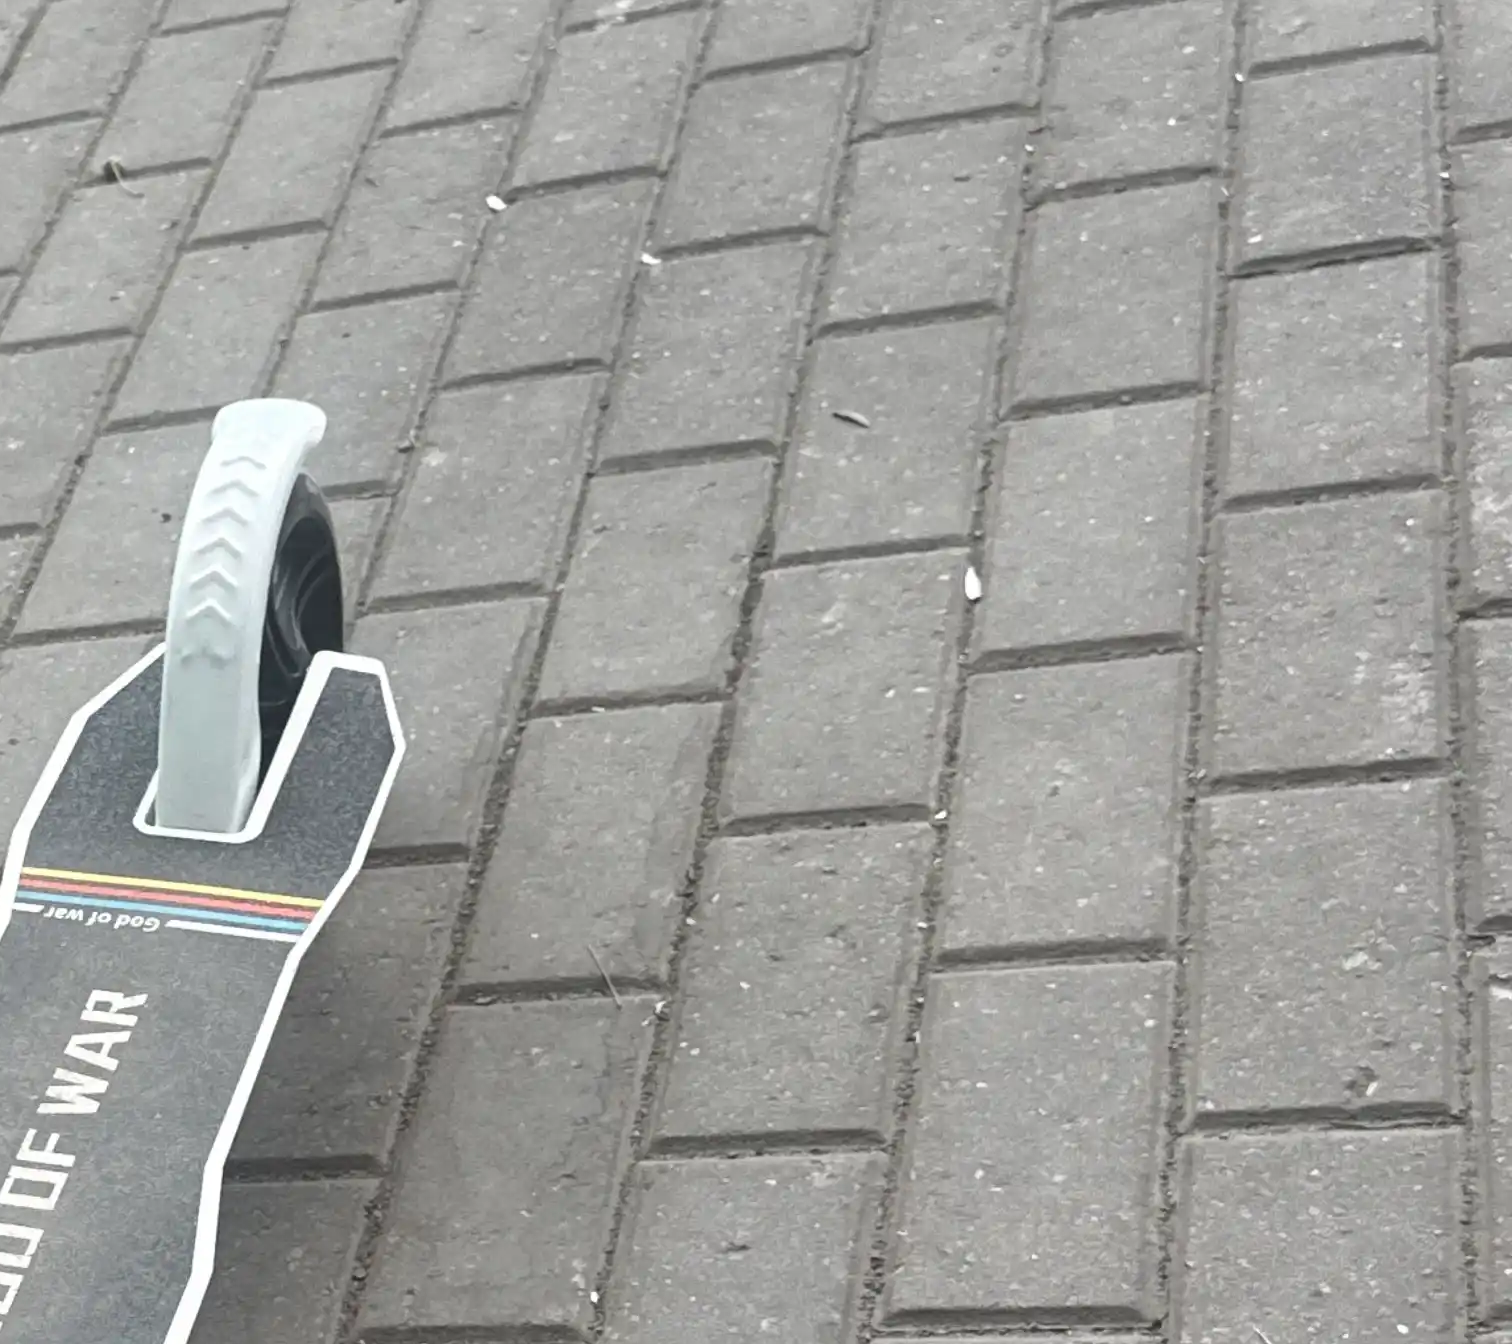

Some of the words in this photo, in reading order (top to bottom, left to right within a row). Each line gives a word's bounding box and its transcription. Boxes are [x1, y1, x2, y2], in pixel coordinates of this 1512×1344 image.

[43, 905, 84, 922] war
[84, 911, 112, 927] of
[113, 913, 161, 933] God
[37, 989, 149, 1115] WAR
